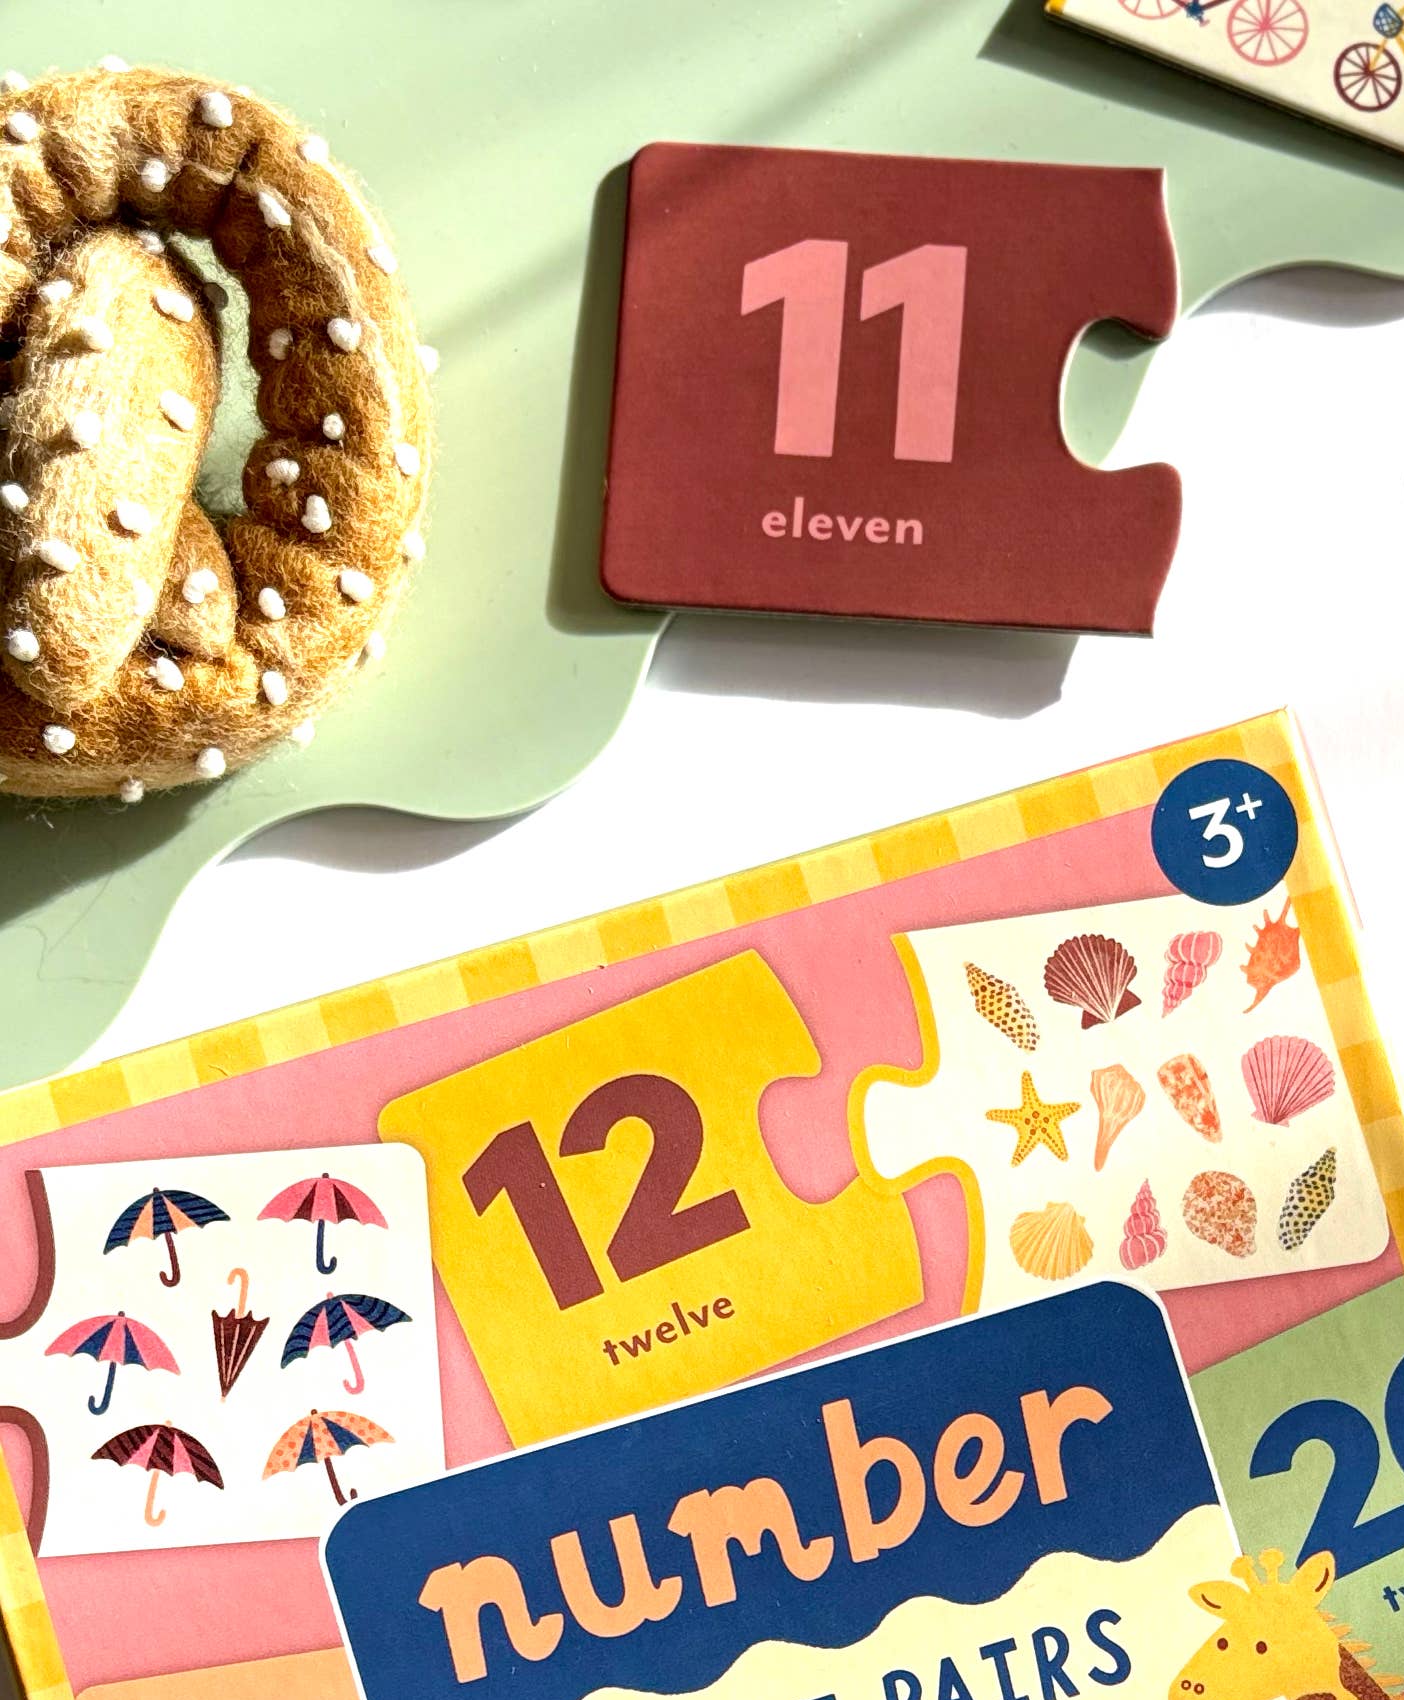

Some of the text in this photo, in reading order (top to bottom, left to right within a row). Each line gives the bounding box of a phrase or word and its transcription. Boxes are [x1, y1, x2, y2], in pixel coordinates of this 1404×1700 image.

[742, 239, 967, 463] 11
[762, 499, 923, 546] eleven
[1188, 791, 1263, 869] 3+
[461, 1073, 752, 1312] 12
[602, 1293, 736, 1367] twelve
[419, 1386, 1114, 1684] number
